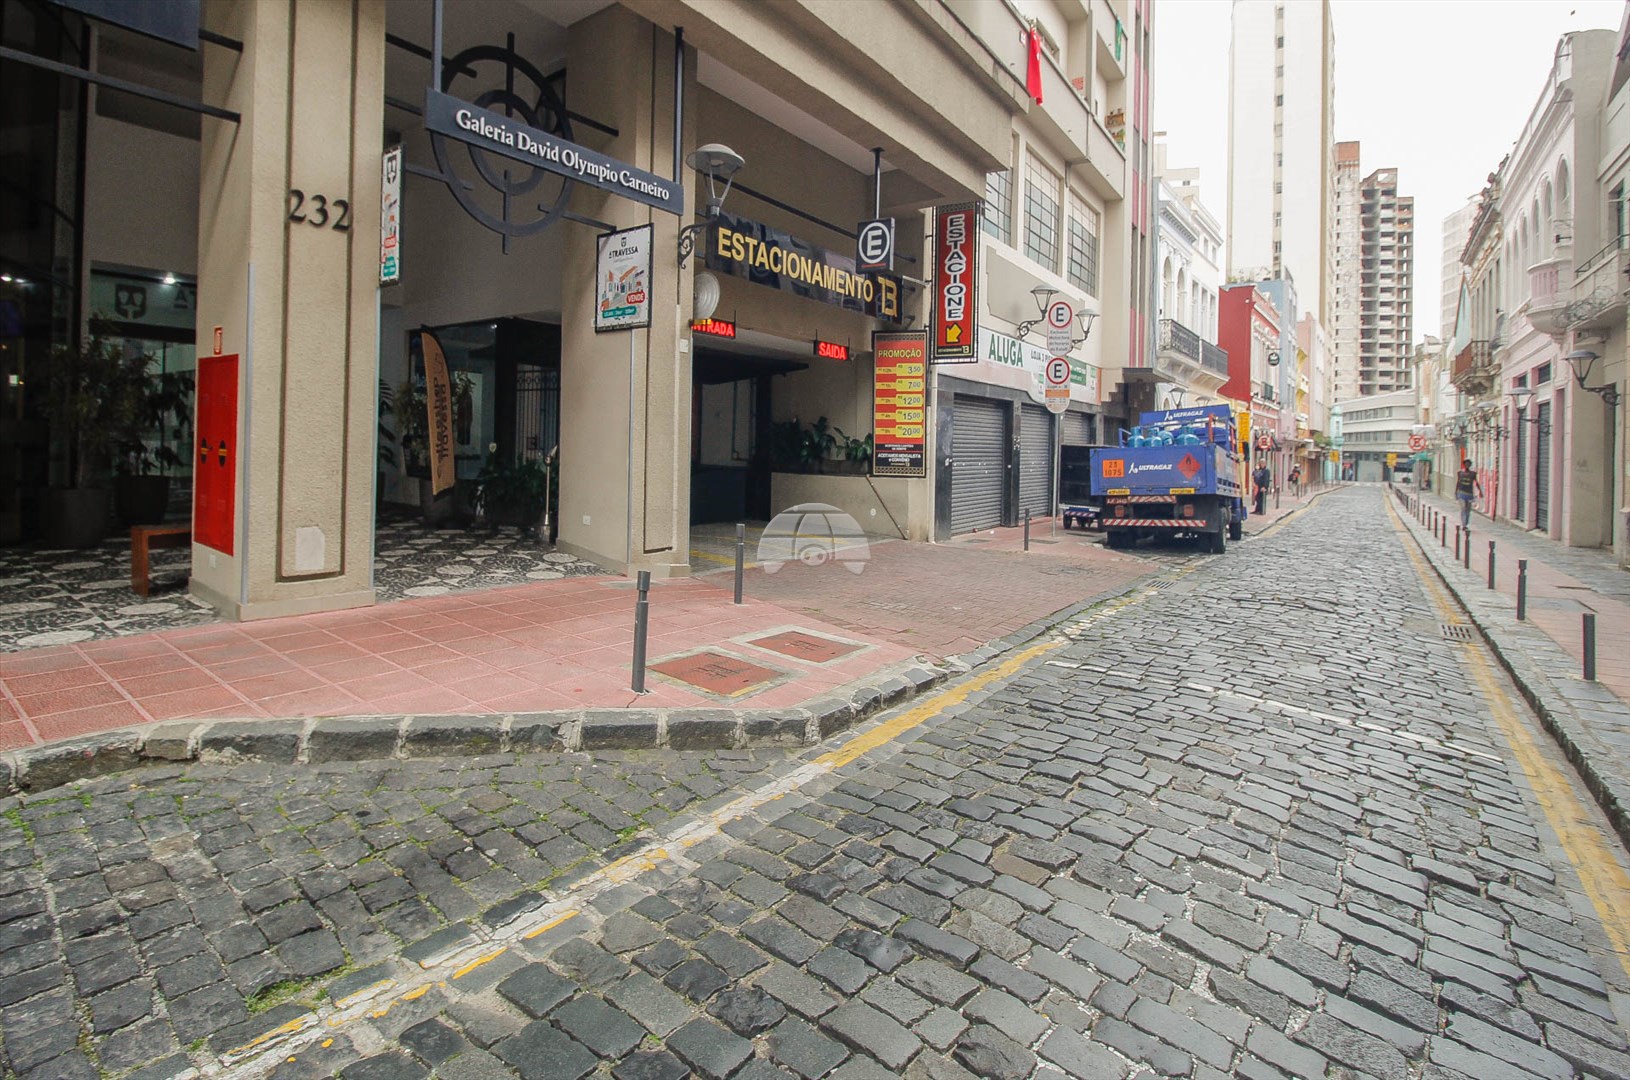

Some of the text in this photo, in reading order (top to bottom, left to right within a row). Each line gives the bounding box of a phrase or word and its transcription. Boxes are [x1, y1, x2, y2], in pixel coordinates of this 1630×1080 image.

[455, 108, 670, 201] Galeria David Olympio Carneiro
[287, 188, 351, 233] 232
[608, 245, 639, 259] ATRAVESSA
[868, 230, 882, 256] E
[718, 226, 898, 316] ESTACIONAMENTO 13
[944, 214, 966, 322] ESTACIONE
[1055, 307, 1065, 322] E
[818, 342, 848, 360] SAIDA
[878, 348, 922, 359] PROMOÇÃO
[988, 333, 1023, 367] ALUGA
[1053, 364, 1063, 378] E
